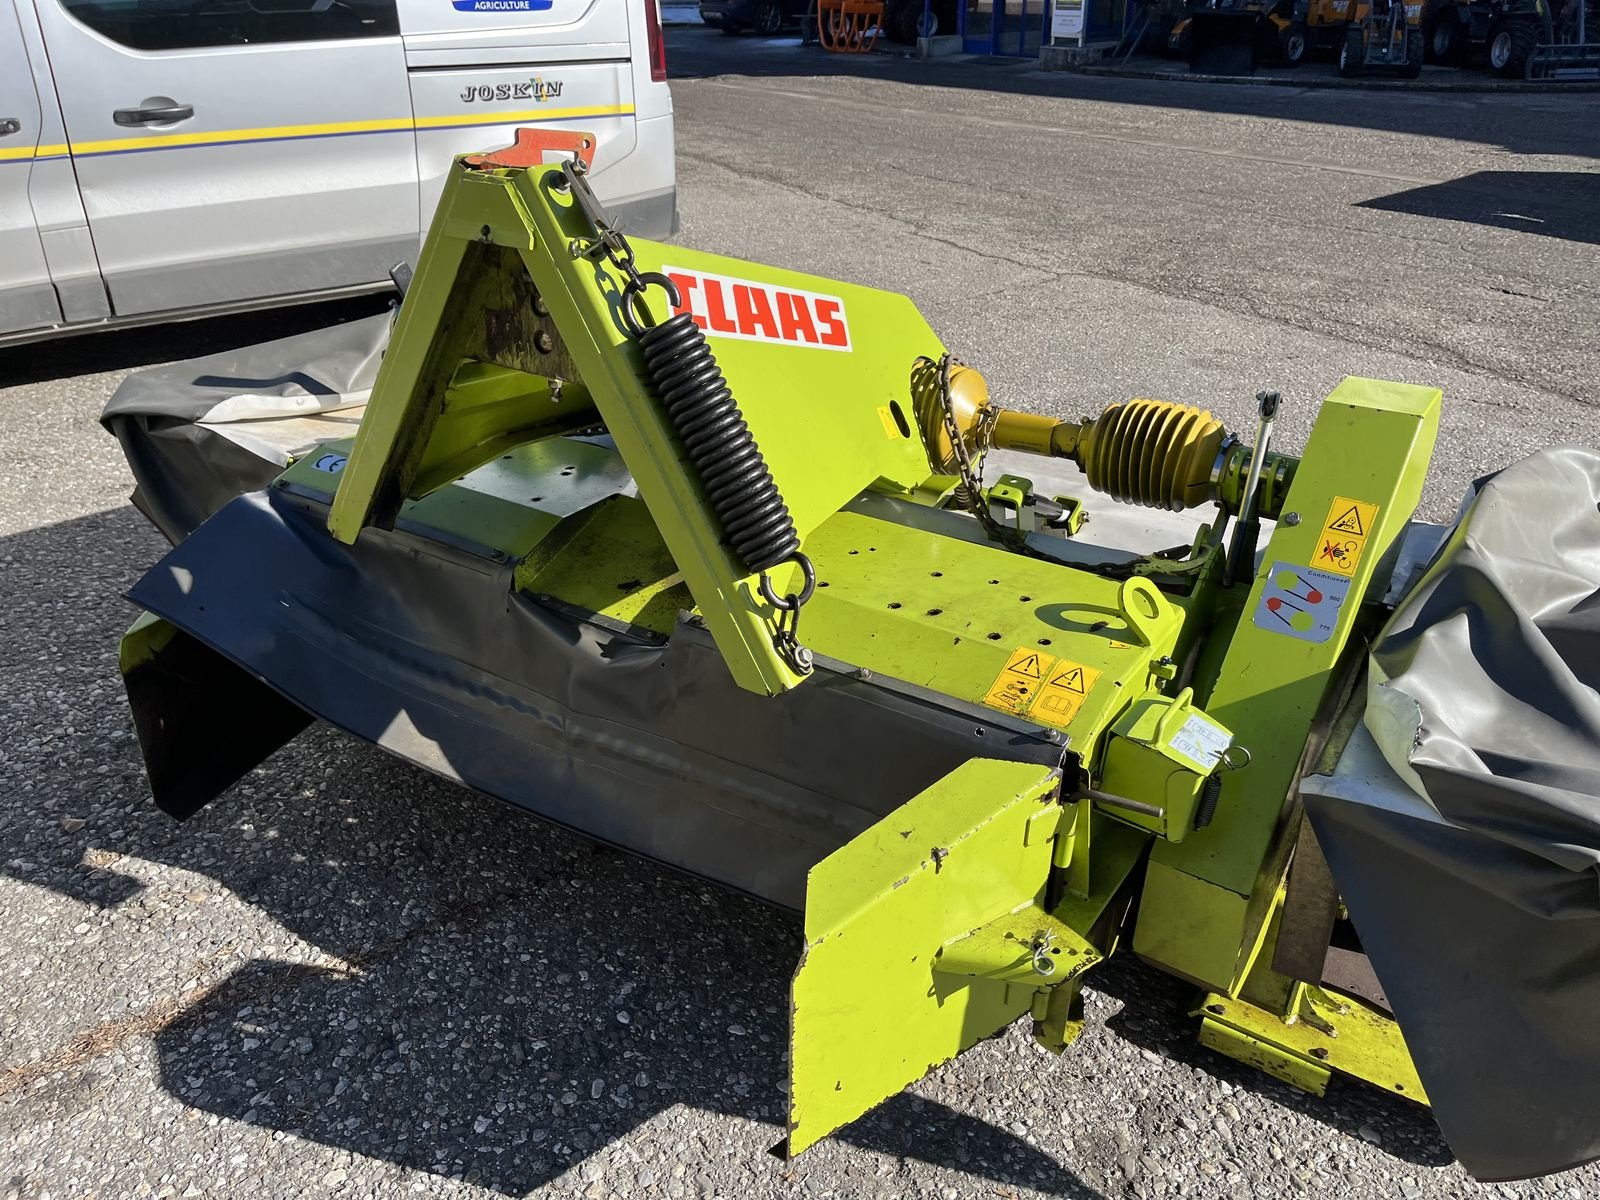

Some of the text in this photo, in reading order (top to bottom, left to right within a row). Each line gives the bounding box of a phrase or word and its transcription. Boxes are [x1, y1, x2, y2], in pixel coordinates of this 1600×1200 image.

[474, 1, 530, 10] AGRICULTURE
[460, 80, 563, 102] JOSKIN
[668, 273, 848, 347] CLAAS
